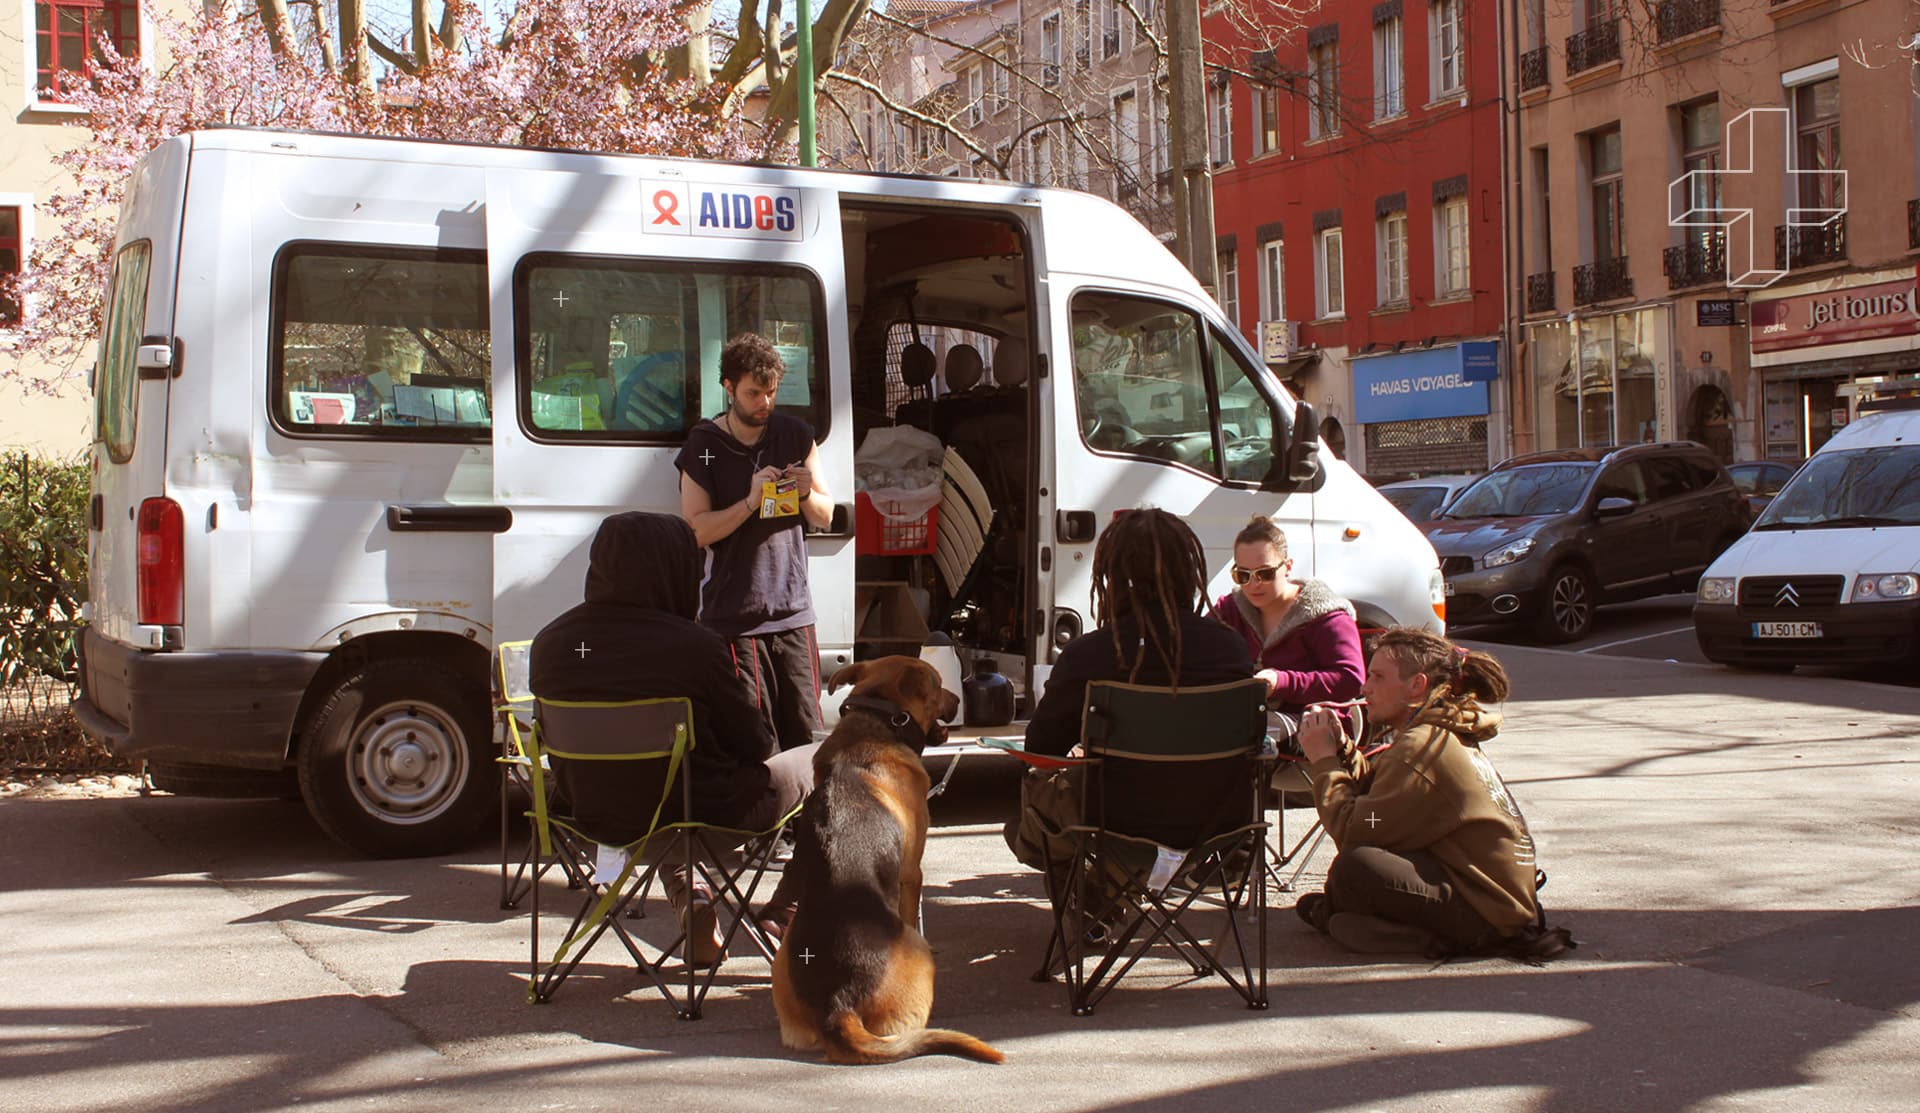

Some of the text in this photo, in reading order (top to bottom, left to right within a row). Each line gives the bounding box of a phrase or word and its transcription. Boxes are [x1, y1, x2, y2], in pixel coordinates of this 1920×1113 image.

[1711, 303, 1732, 312] MSC
[1804, 292, 1907, 331] Jet tours
[1370, 379, 1411, 396] HAVAS
